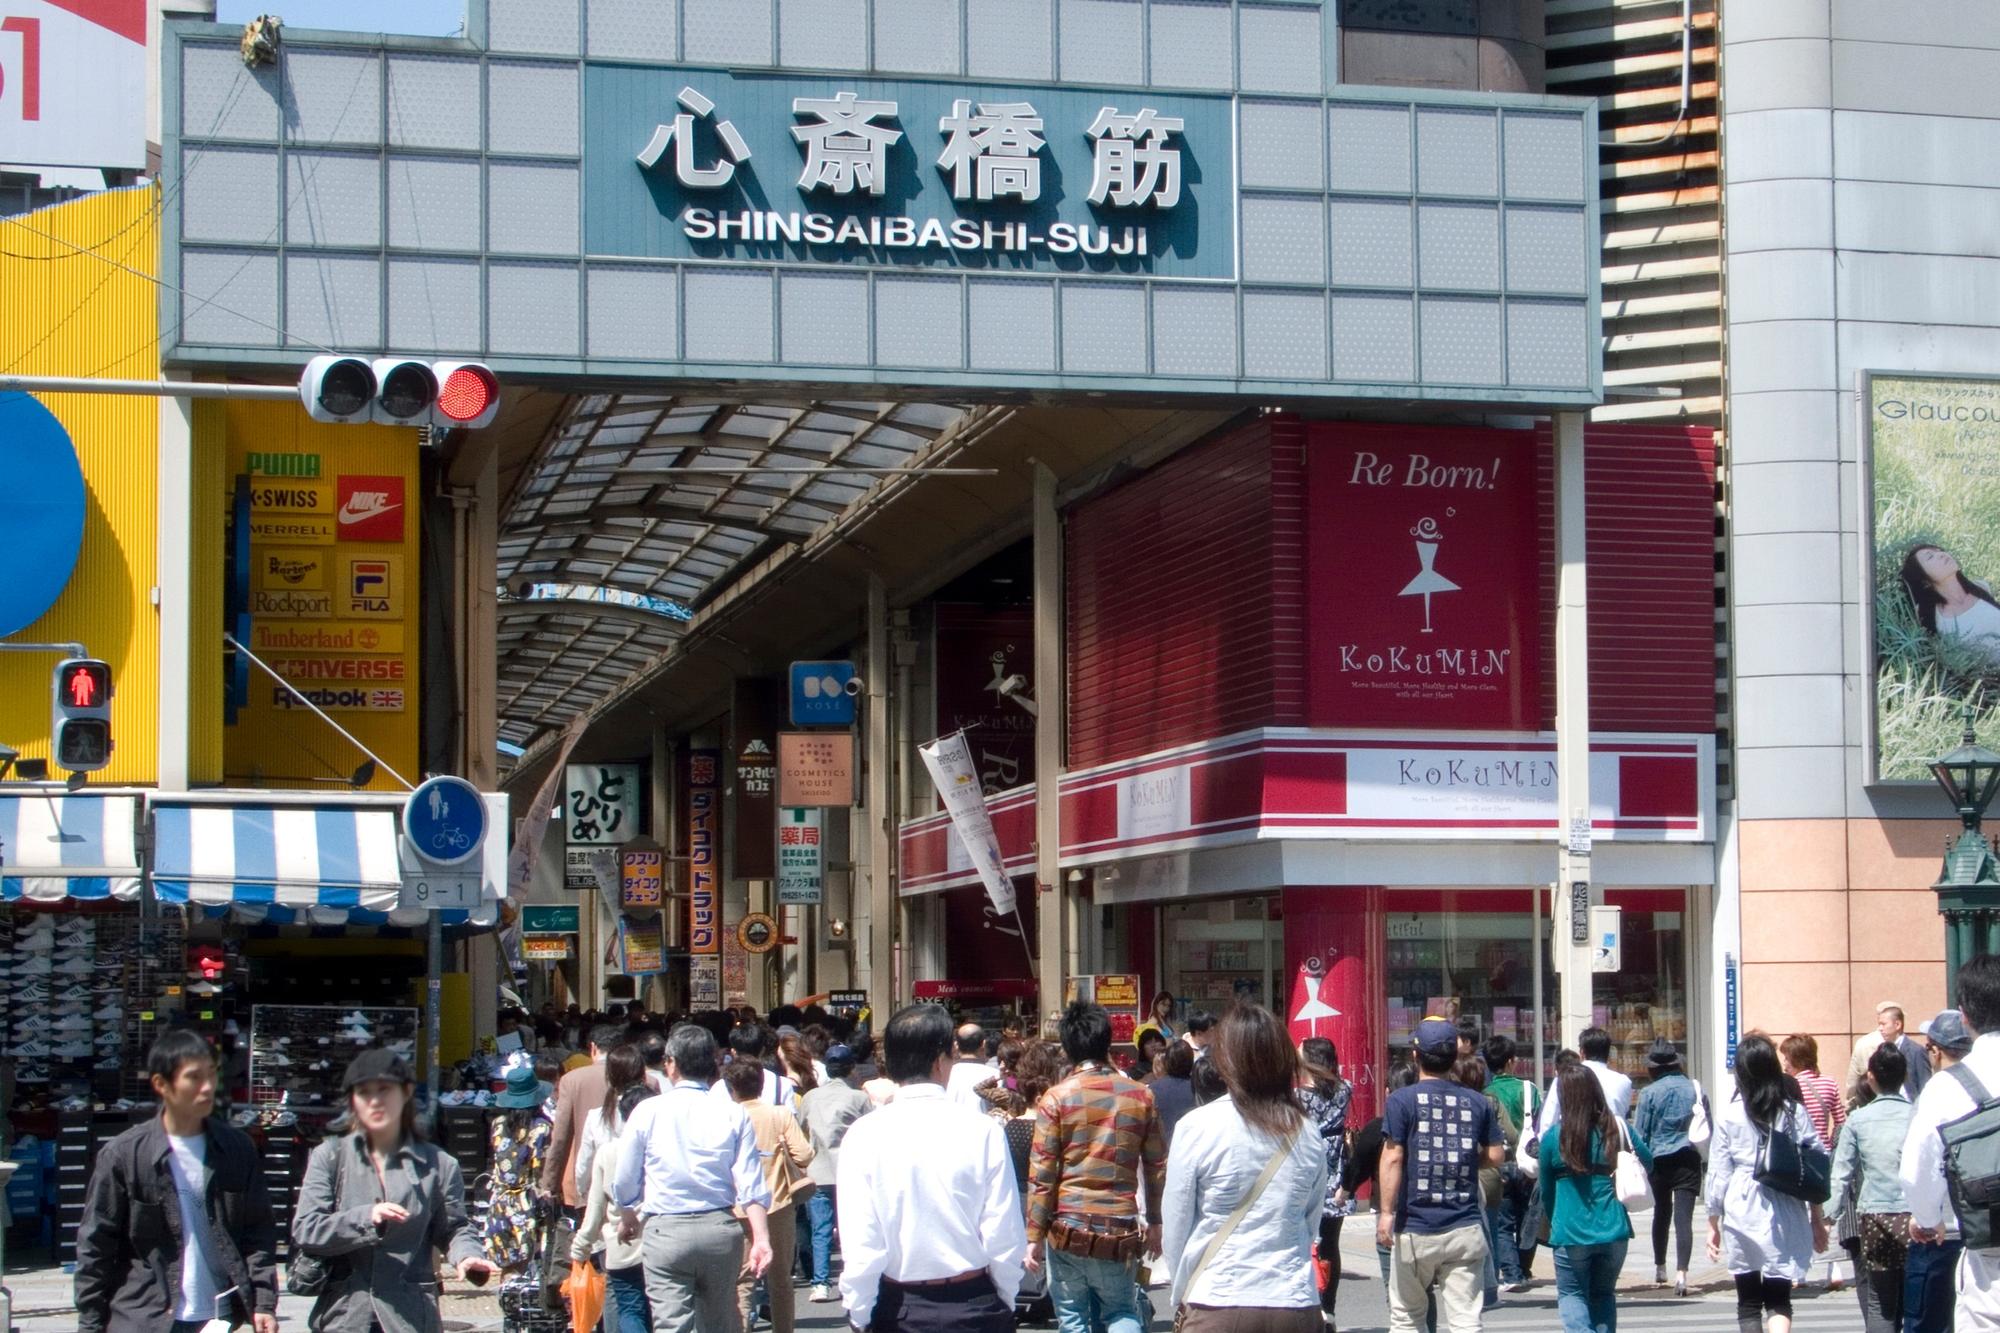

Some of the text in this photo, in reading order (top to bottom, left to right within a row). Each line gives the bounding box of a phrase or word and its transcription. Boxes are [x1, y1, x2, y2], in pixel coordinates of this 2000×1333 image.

[0, 17, 40, 121] 1
[637, 86, 1184, 208] 心斎橋筋
[683, 207, 1148, 256] SHINSAIBASHI-SUJI
[247, 452, 321, 477] PUMA
[1348, 451, 1500, 490] Re Born!
[348, 491, 388, 510] NIKE
[254, 592, 331, 617] Rockport
[352, 600, 389, 612] FILA
[258, 623, 354, 649] Timberland
[271, 659, 404, 679] CONVERSE
[273, 687, 367, 710] Reebok
[786, 769, 846, 777] COSMETICS
[799, 779, 833, 787] HOUSE
[780, 827, 819, 845] 薬局
[625, 853, 659, 865] クスリ
[638, 867, 646, 875] の
[624, 890, 659, 901] チェーン
